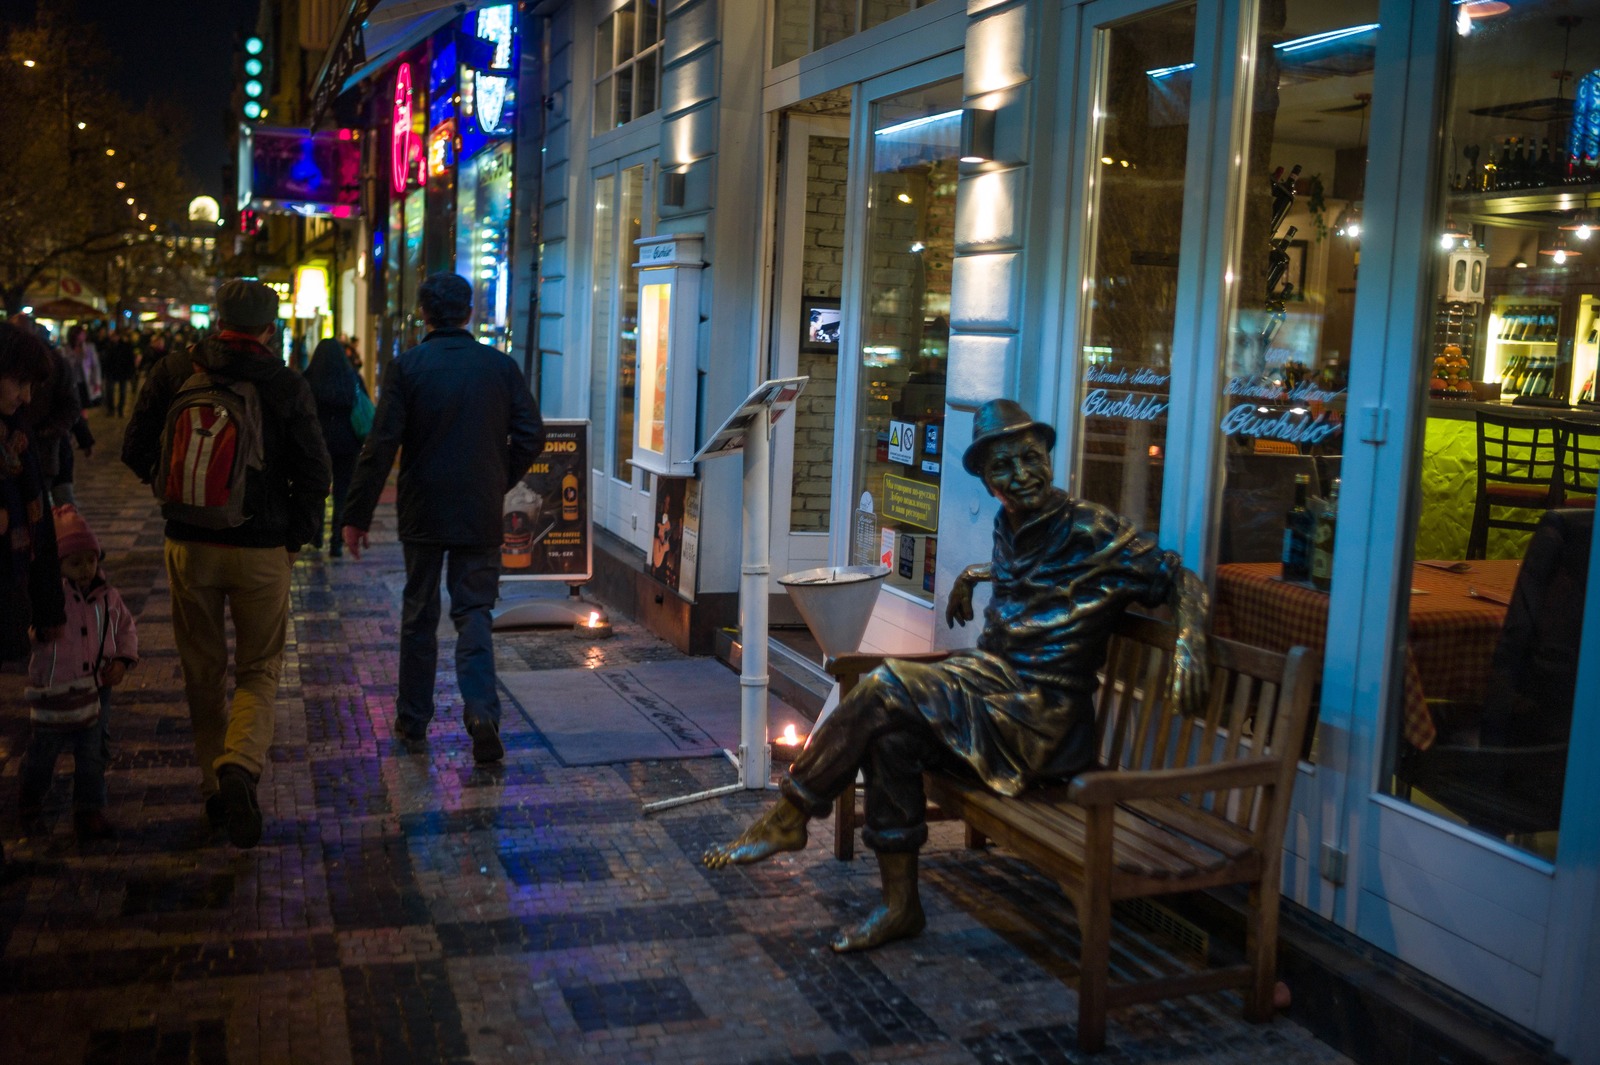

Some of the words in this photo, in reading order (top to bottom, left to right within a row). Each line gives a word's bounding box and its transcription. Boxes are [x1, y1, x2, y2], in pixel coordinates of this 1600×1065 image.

[1083, 364, 1127, 384] Ristorante
[1129, 366, 1170, 385] italiano
[1223, 376, 1283, 399] Ristorante
[1287, 379, 1347, 402] italiano
[543, 440, 577, 453] DINO
